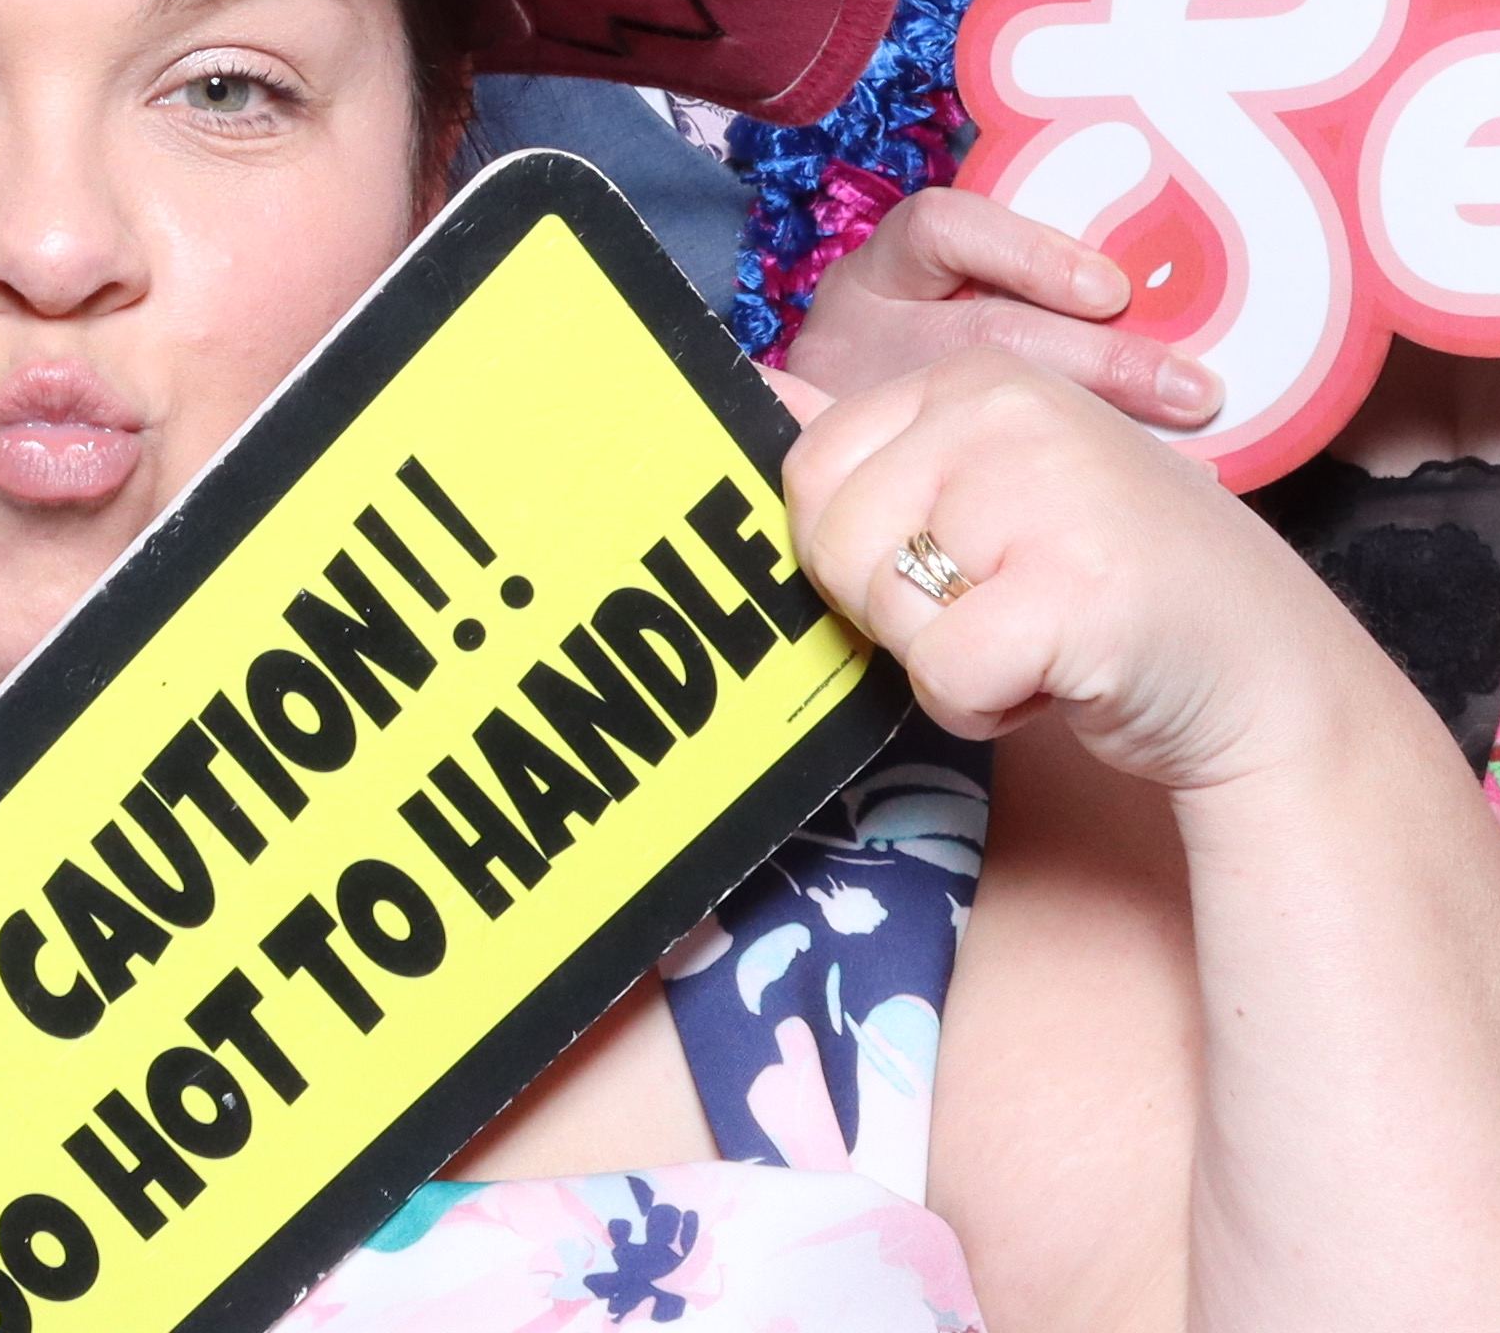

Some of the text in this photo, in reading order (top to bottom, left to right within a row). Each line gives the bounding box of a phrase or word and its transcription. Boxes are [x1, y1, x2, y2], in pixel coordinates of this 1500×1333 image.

[60, 967, 310, 1241] HOT
[259, 858, 447, 1035] TO
[397, 474, 829, 921] HANDLE
